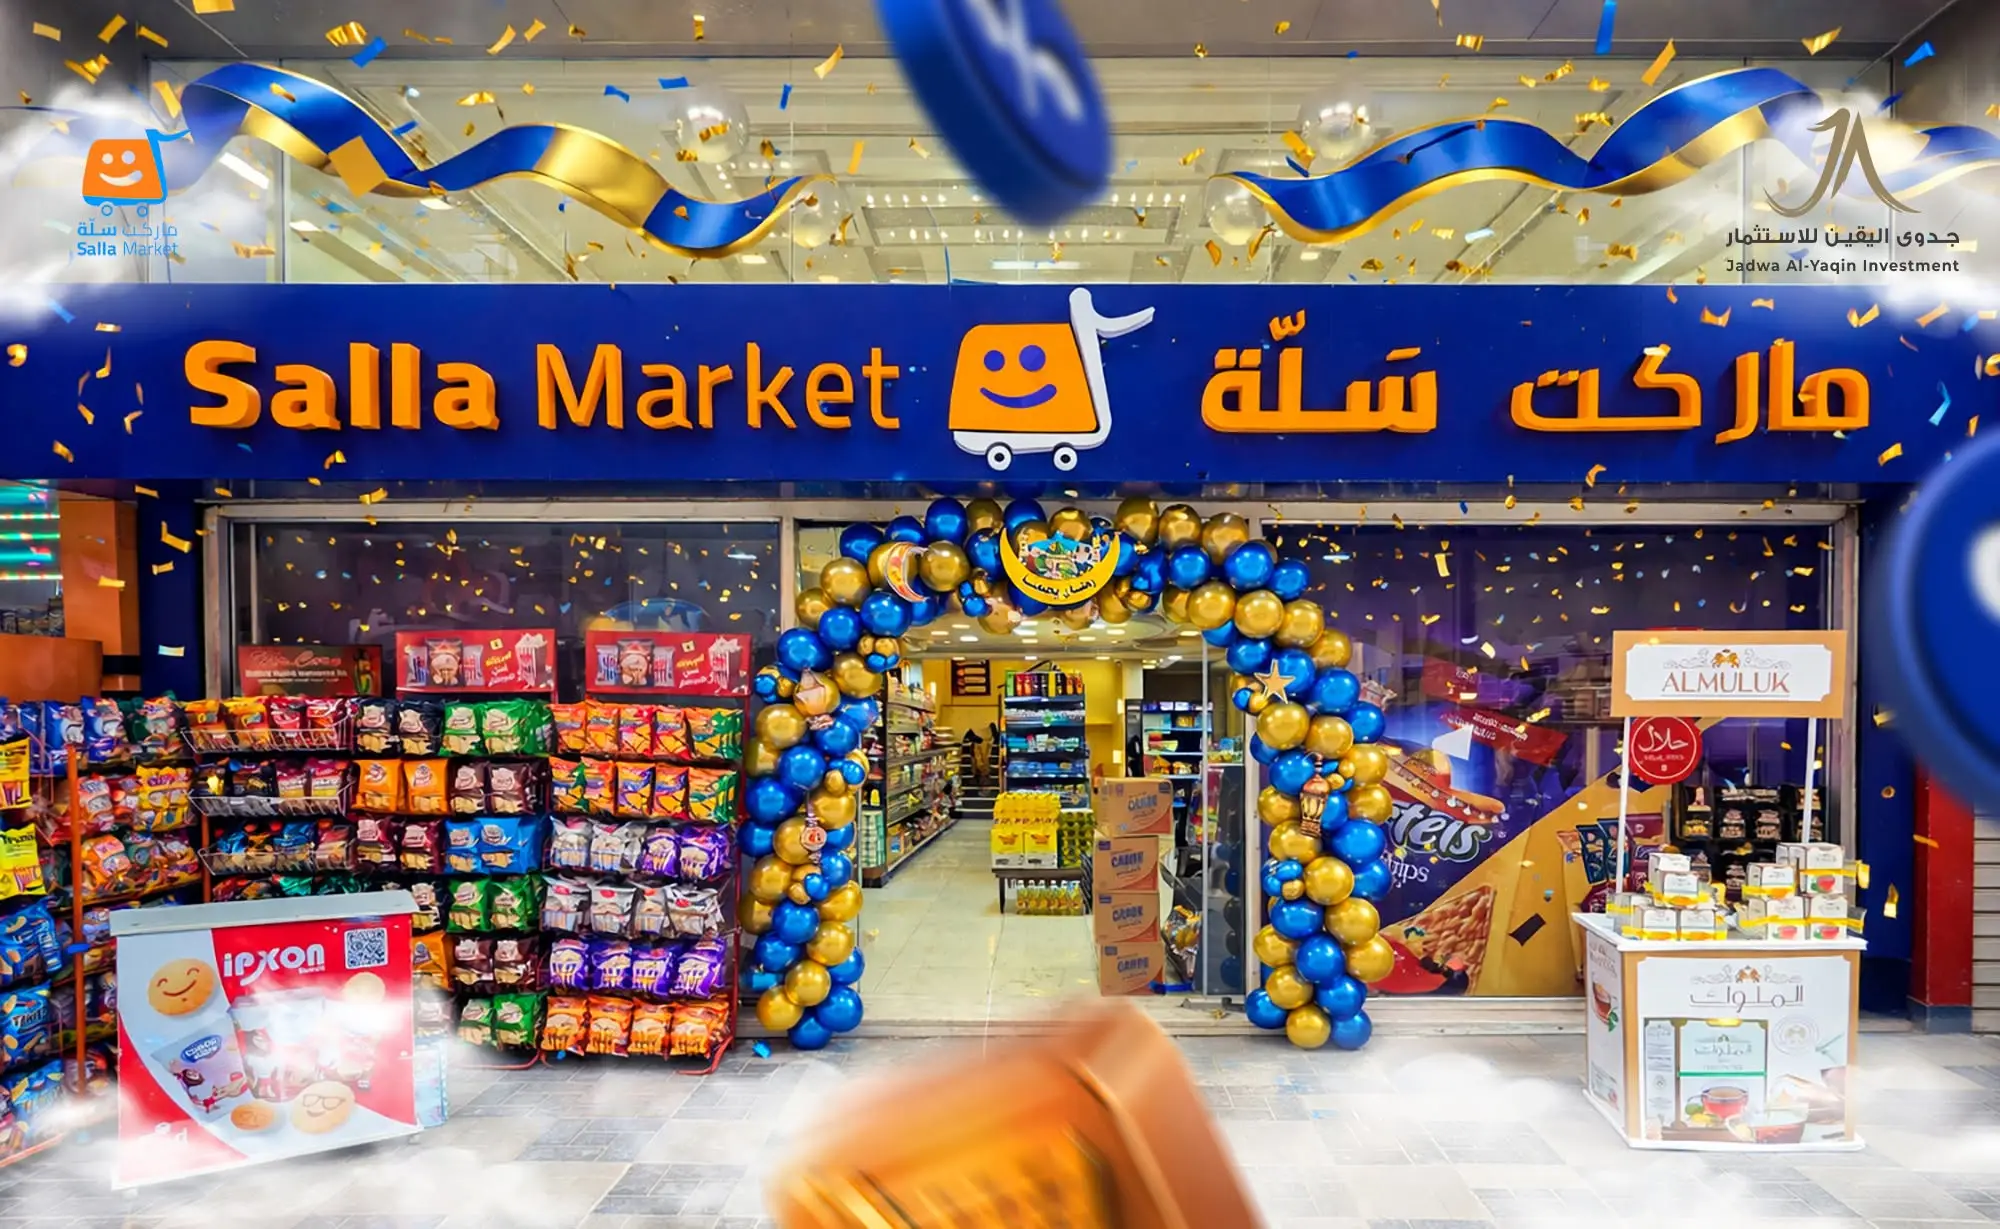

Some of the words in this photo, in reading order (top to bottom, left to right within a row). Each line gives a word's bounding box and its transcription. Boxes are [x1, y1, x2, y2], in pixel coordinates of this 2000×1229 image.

[184, 339, 500, 431] Salla
[536, 340, 901, 431] Market
[1509, 338, 1870, 444] ماركت
[1661, 670, 1791, 694] ALMULUK
[1637, 723, 1689, 753] حلال
